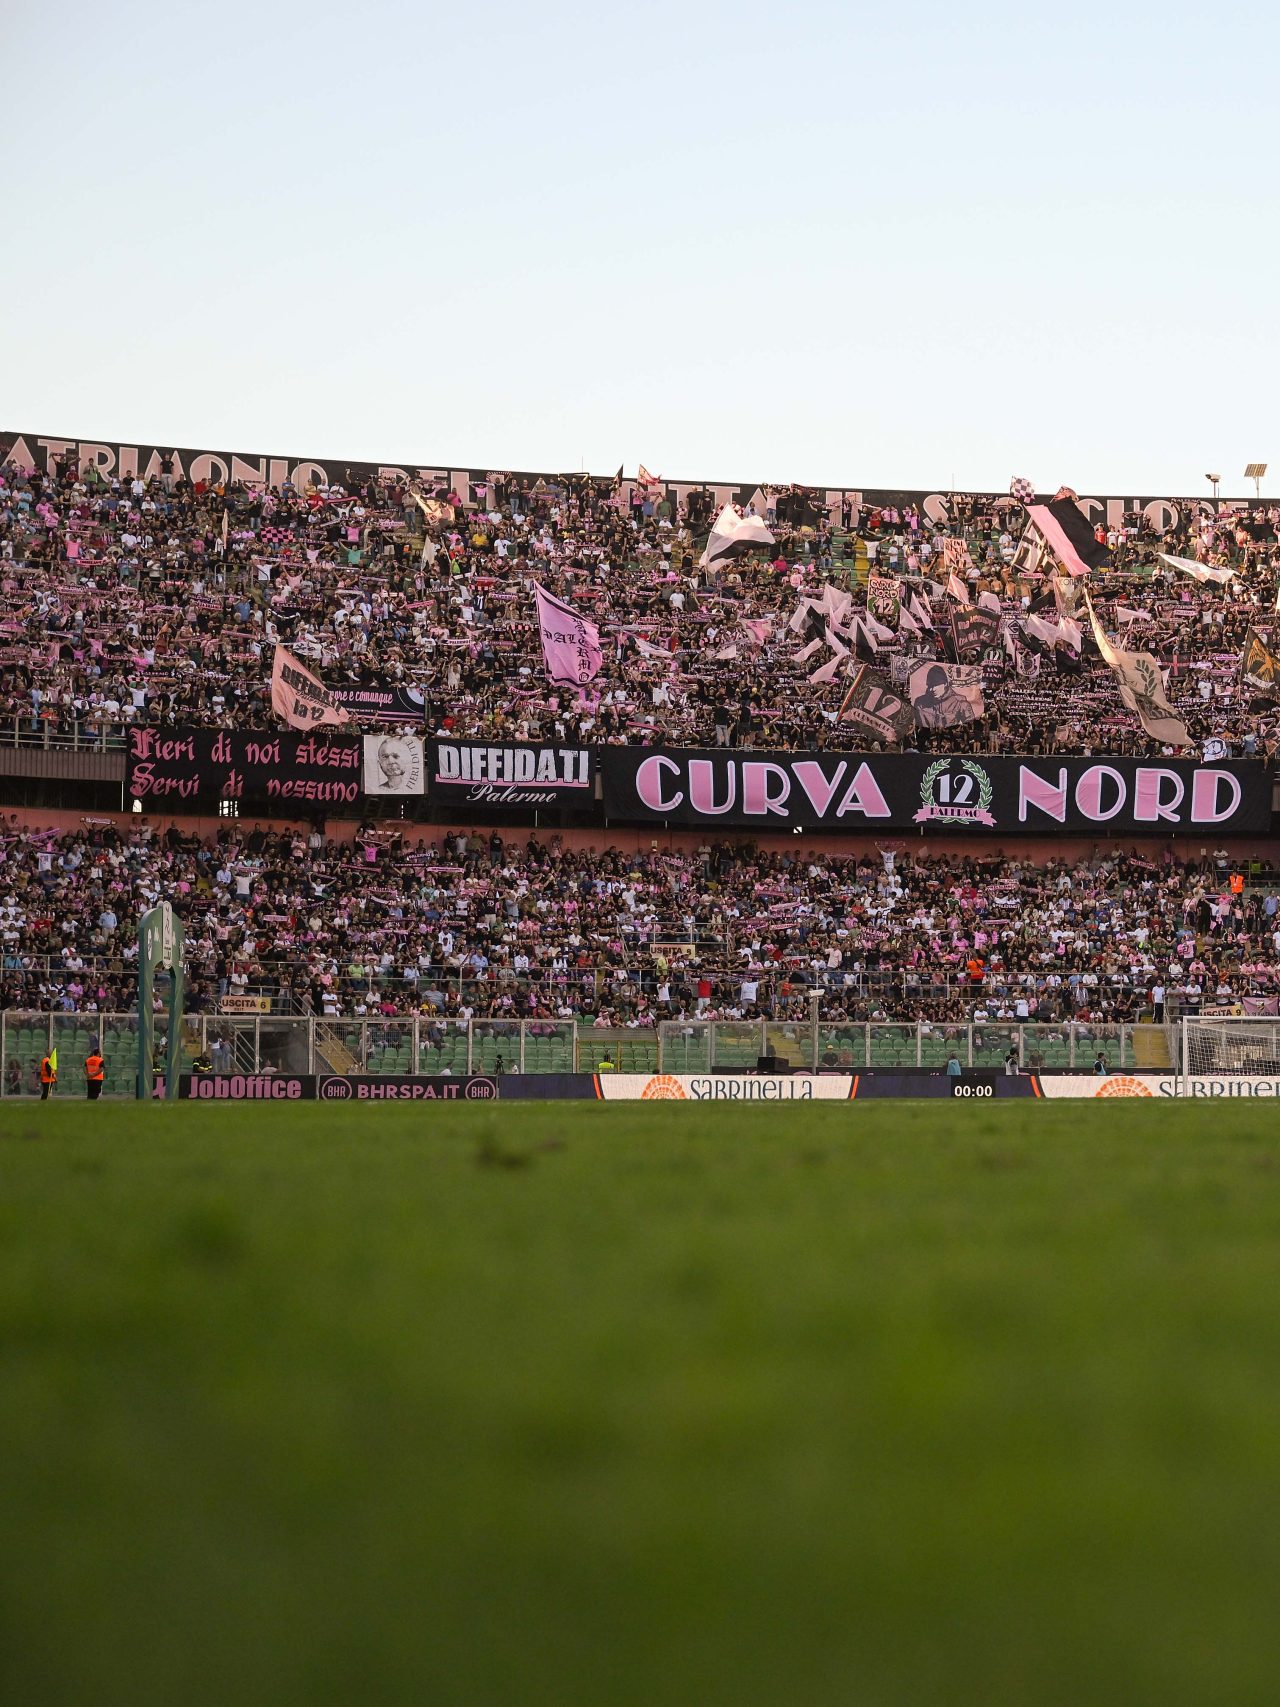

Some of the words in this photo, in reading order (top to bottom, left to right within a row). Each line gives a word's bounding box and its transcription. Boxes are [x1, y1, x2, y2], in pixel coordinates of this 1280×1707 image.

[863, 686, 902, 722] 12
[212, 731, 232, 764] di
[245, 738, 280, 765] noi
[295, 736, 360, 769] stessi
[437, 744, 590, 784] DIFFIDATI
[129, 762, 199, 798] Servi
[222, 768, 243, 799] di
[266, 778, 358, 803] nessuno
[465, 783, 557, 803] Palermo
[636, 755, 892, 818] CURVA
[1018, 764, 1242, 823] NORD
[937, 774, 973, 805] 12
[930, 807, 981, 819] PALERMO
[222, 999, 257, 1008] USCITA
[260, 1001, 266, 1009] 6
[189, 1075, 302, 1099] JobOffice
[327, 1086, 346, 1096] BHR
[357, 1084, 460, 1099] BHRSPA.IT
[471, 1086, 490, 1096] BHR
[954, 1085, 993, 1097] 00:00
